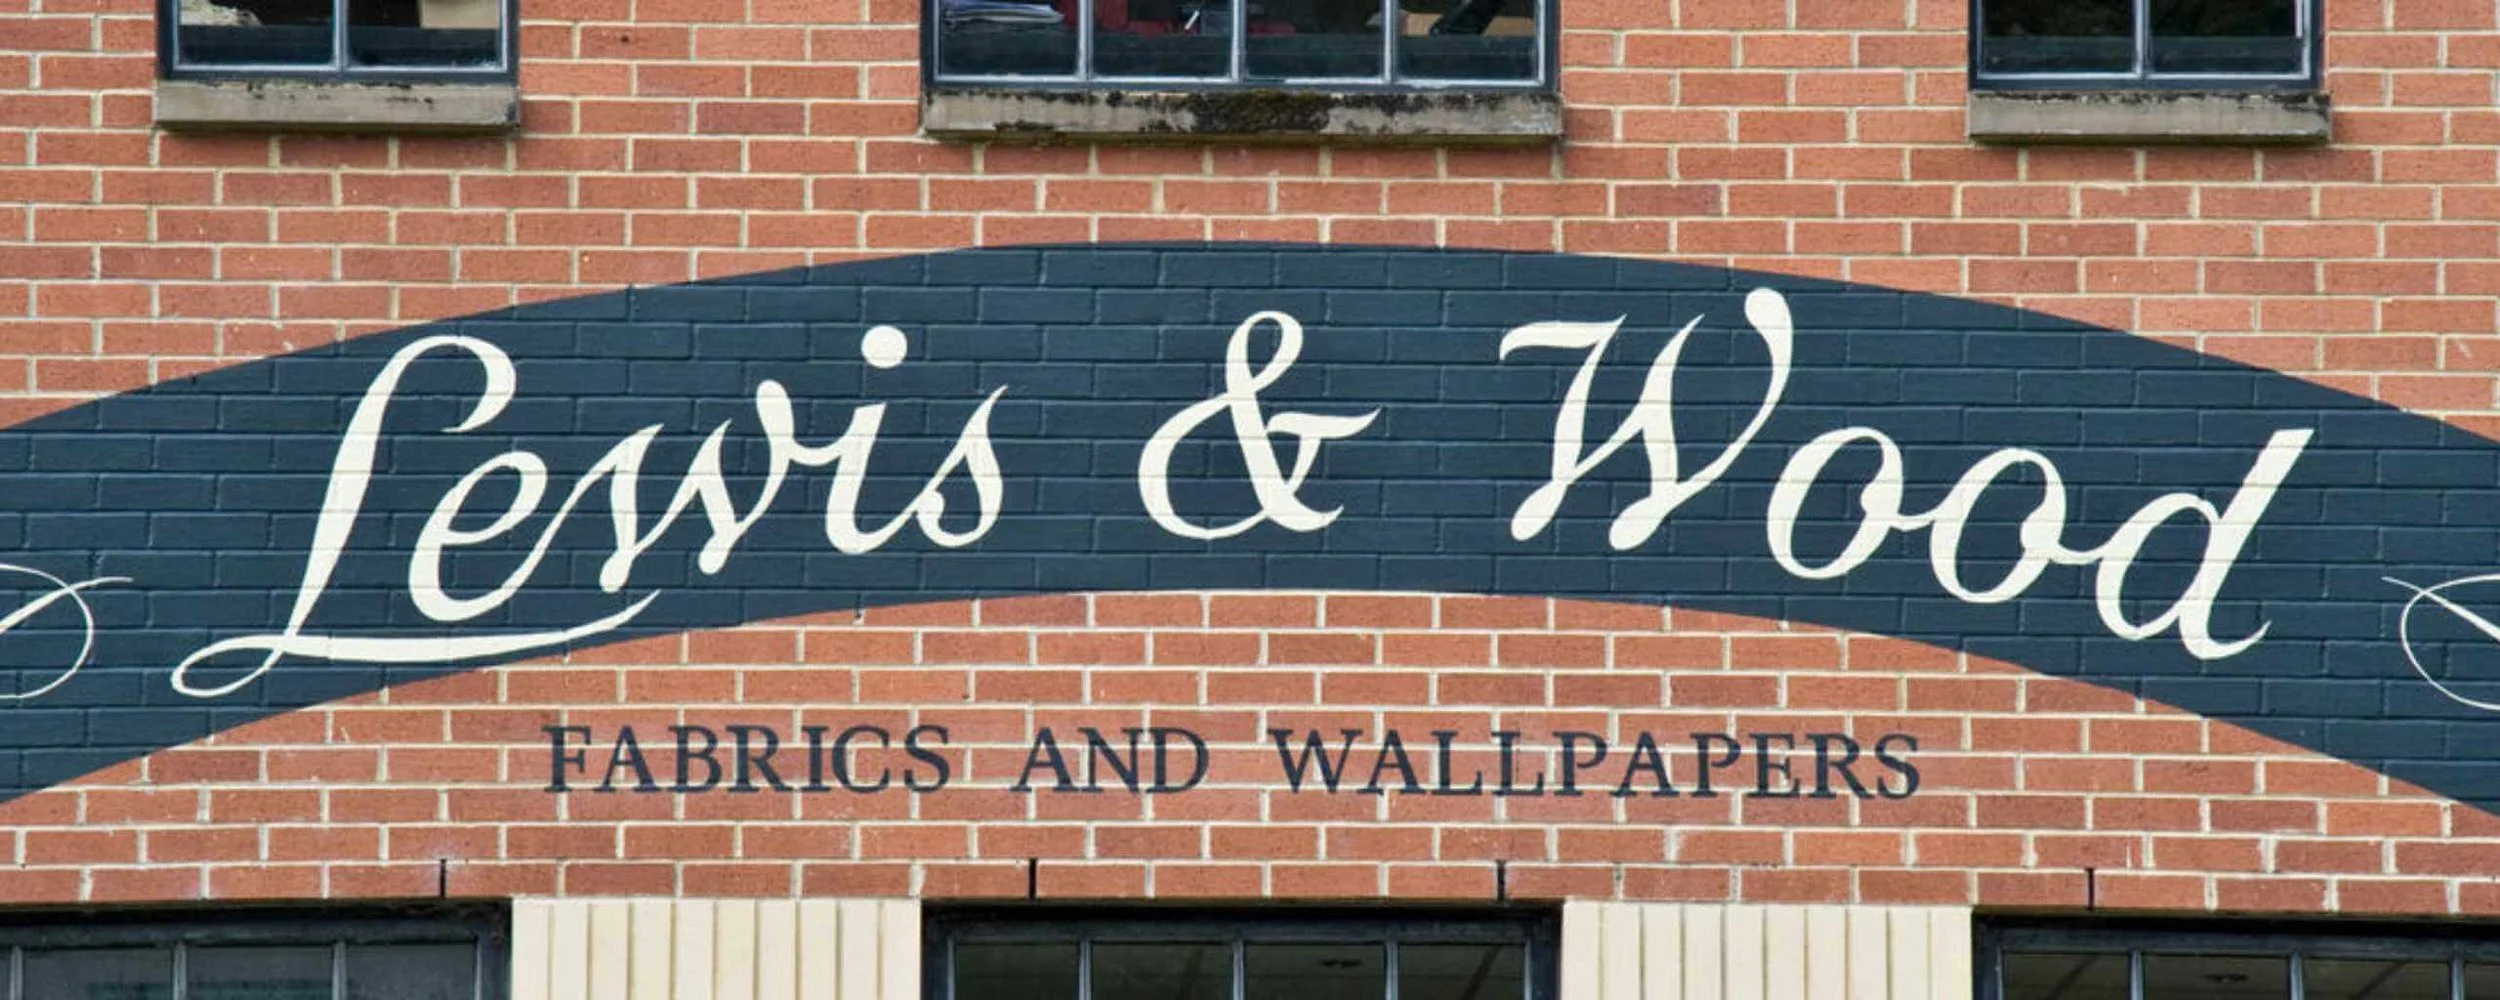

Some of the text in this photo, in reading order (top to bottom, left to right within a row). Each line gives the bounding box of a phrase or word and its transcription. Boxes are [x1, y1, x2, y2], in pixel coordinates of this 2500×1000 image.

[171, 287, 2314, 697] Lewis & Wood
[543, 725, 1920, 799] FABRICS AND WALLPAPERS
